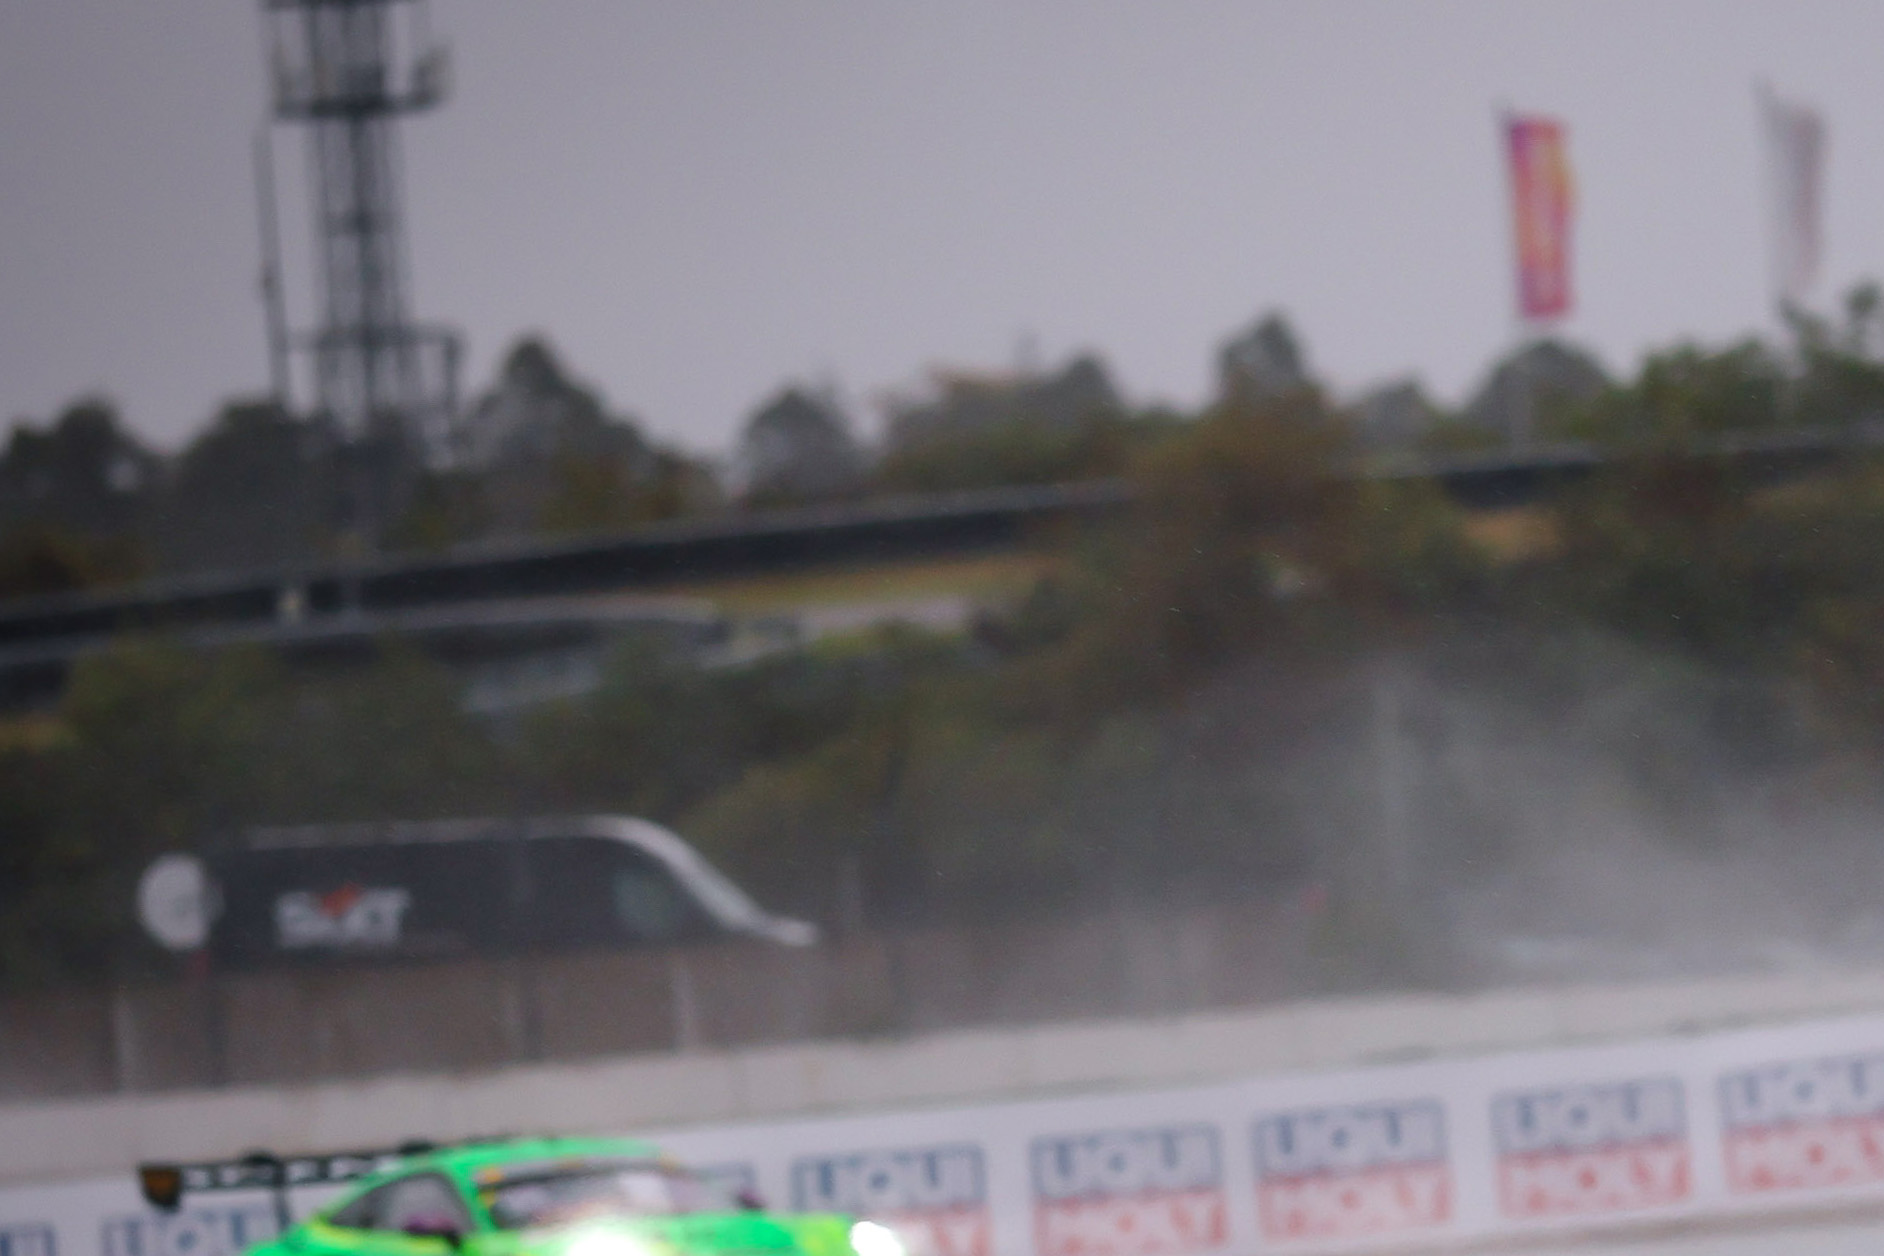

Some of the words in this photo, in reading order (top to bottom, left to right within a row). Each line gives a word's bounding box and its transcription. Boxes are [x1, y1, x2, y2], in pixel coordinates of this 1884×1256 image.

[1250, 1096, 1447, 1182] LIQUI
[1491, 1074, 1687, 1155] LIQUI
[1027, 1121, 1223, 1203] LIQUI
[1257, 1163, 1453, 1243] MOLY
[1499, 1133, 1691, 1217] MOLY
